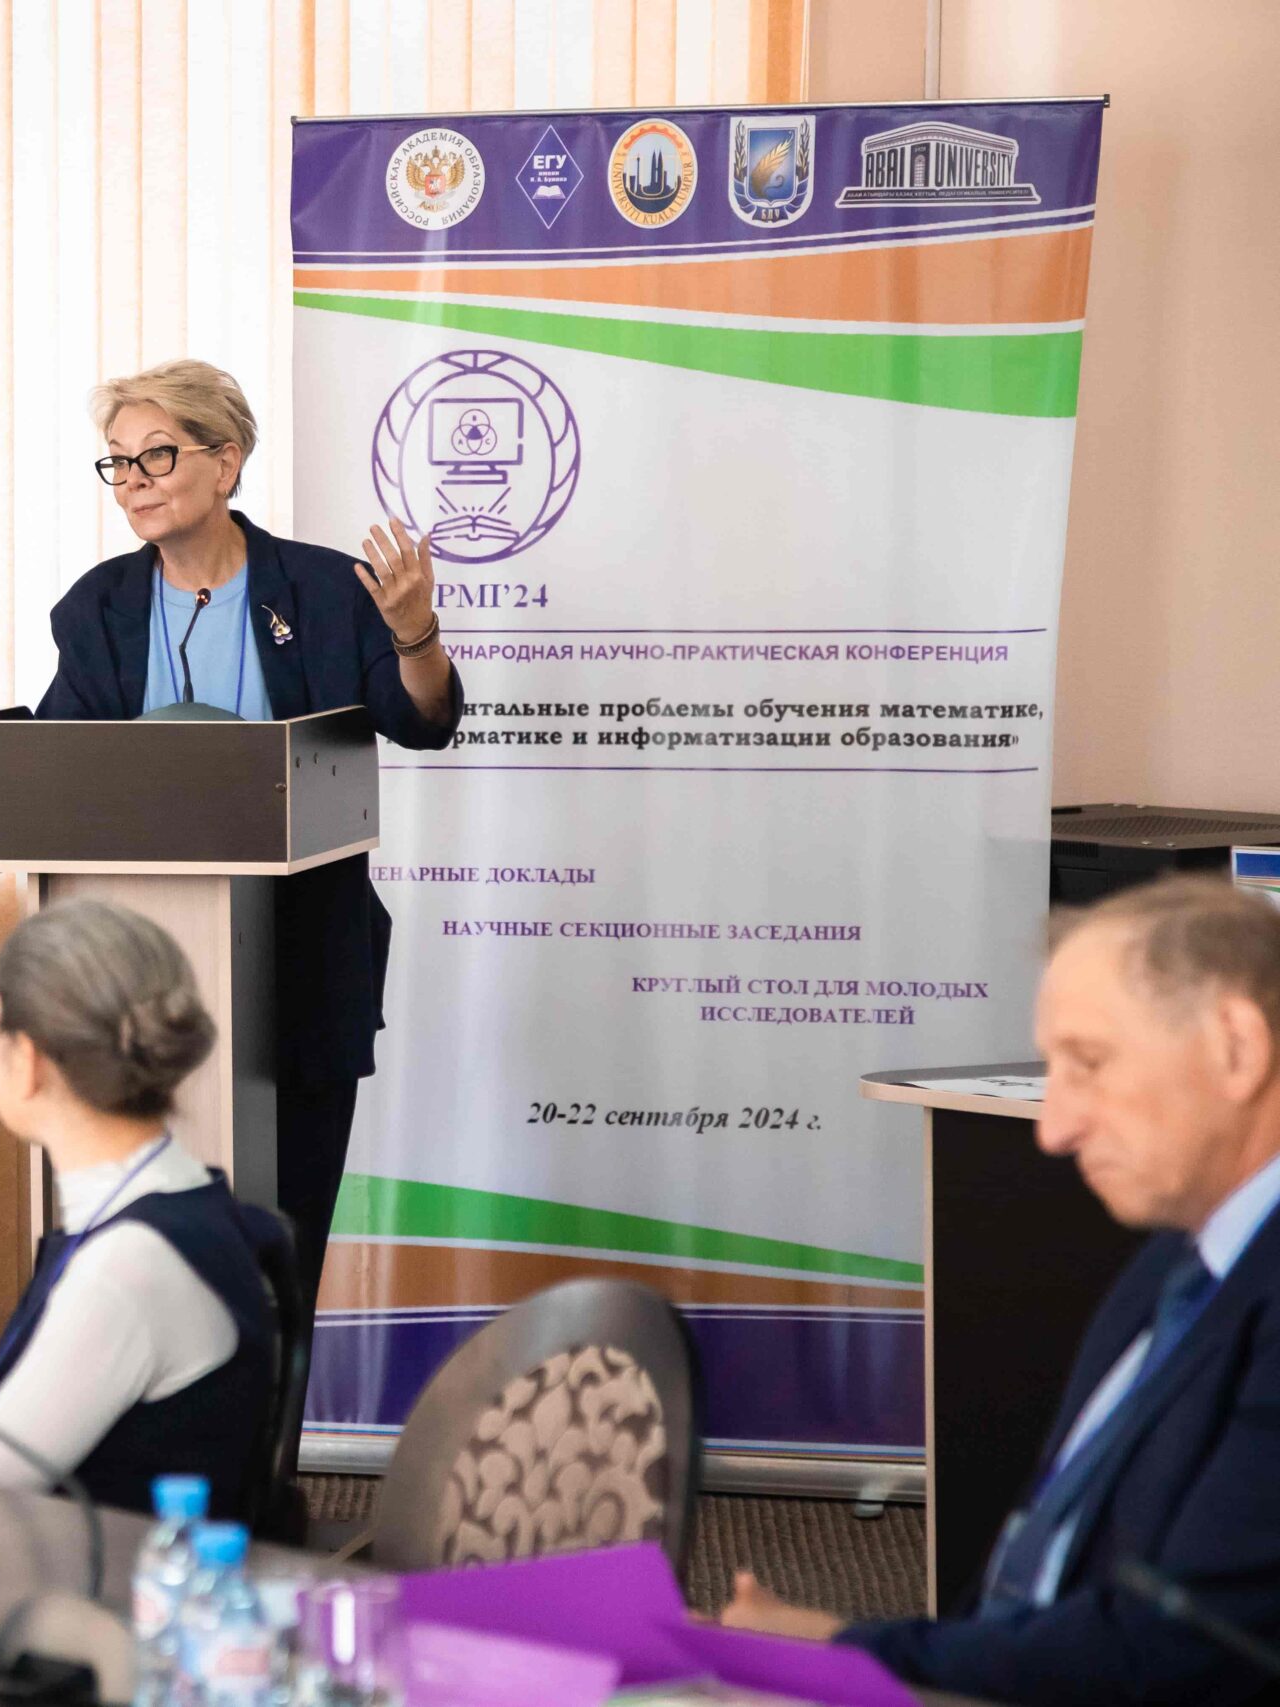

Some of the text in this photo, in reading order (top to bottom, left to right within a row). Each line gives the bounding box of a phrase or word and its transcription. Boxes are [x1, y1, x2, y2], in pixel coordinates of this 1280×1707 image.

[532, 154, 567, 170] ЕГУ
[865, 142, 1014, 188] ABAI UNIVERSITY
[389, 132, 481, 227] РОССИЙСКАЯ АКАДЕМИЯ ОБРАЗОВАНИЯ
[612, 162, 694, 225] UNIVERSITI KUALA LUMPUR
[435, 583, 549, 608] PMI’24
[442, 644, 1009, 665] УНАРОДНАЯ НАУЧНО-ПРАКТИЧЕСКАЯ КОНФЕРЕНЦИЯ
[463, 698, 1044, 722] нтальные проблемы обучения математике,
[452, 726, 1019, 750] рматике и информатизации образования»
[485, 867, 596, 884] ДОКЛАДЫ
[442, 920, 862, 942] НАУЧНЫЕ СЕКЦИОННЫЕ ЗАСЕДАНИЯ
[631, 974, 990, 999] КРУГЛЫЙ СТОЛ ДЛЯ МОЛОДЫХ
[700, 1004, 916, 1026] ИССЛЕДОВАТЕЛЕЙ
[526, 1102, 822, 1134] 20-22 сентября 2024 г.
